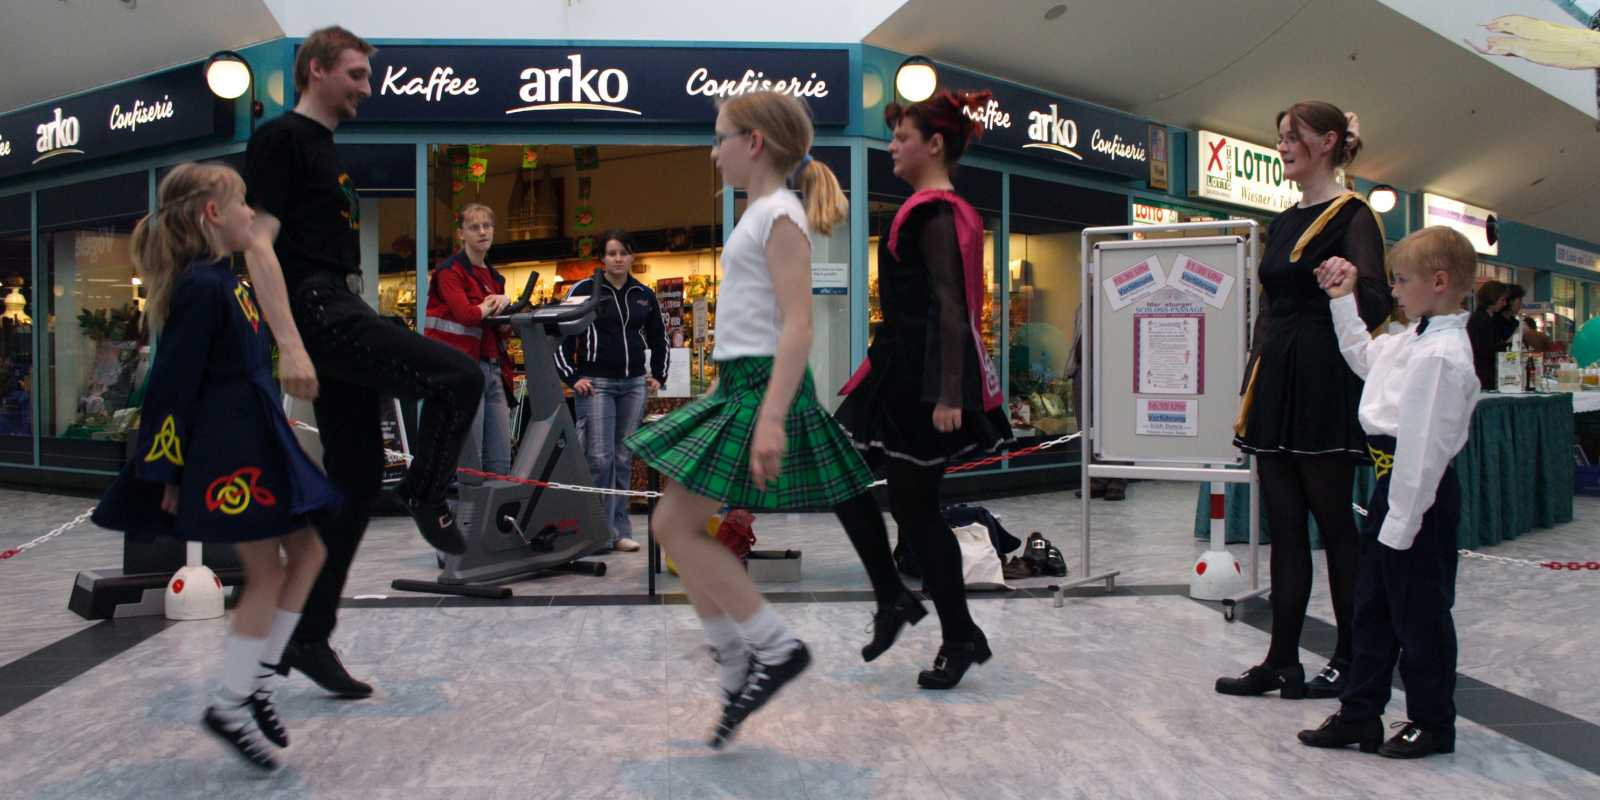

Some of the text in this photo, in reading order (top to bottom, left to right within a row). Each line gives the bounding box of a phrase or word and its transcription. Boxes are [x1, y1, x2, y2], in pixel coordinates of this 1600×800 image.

[380, 66, 480, 102] Kaffee
[519, 54, 629, 103] arko
[686, 67, 829, 98] Confiserie
[36, 107, 80, 153] arko
[110, 94, 174, 132] Confiserie
[1028, 104, 1078, 148] arko
[1091, 128, 1146, 162] Confiserie
[1235, 146, 1282, 187] LOTTO
[1136, 203, 1164, 223] LOTTO
